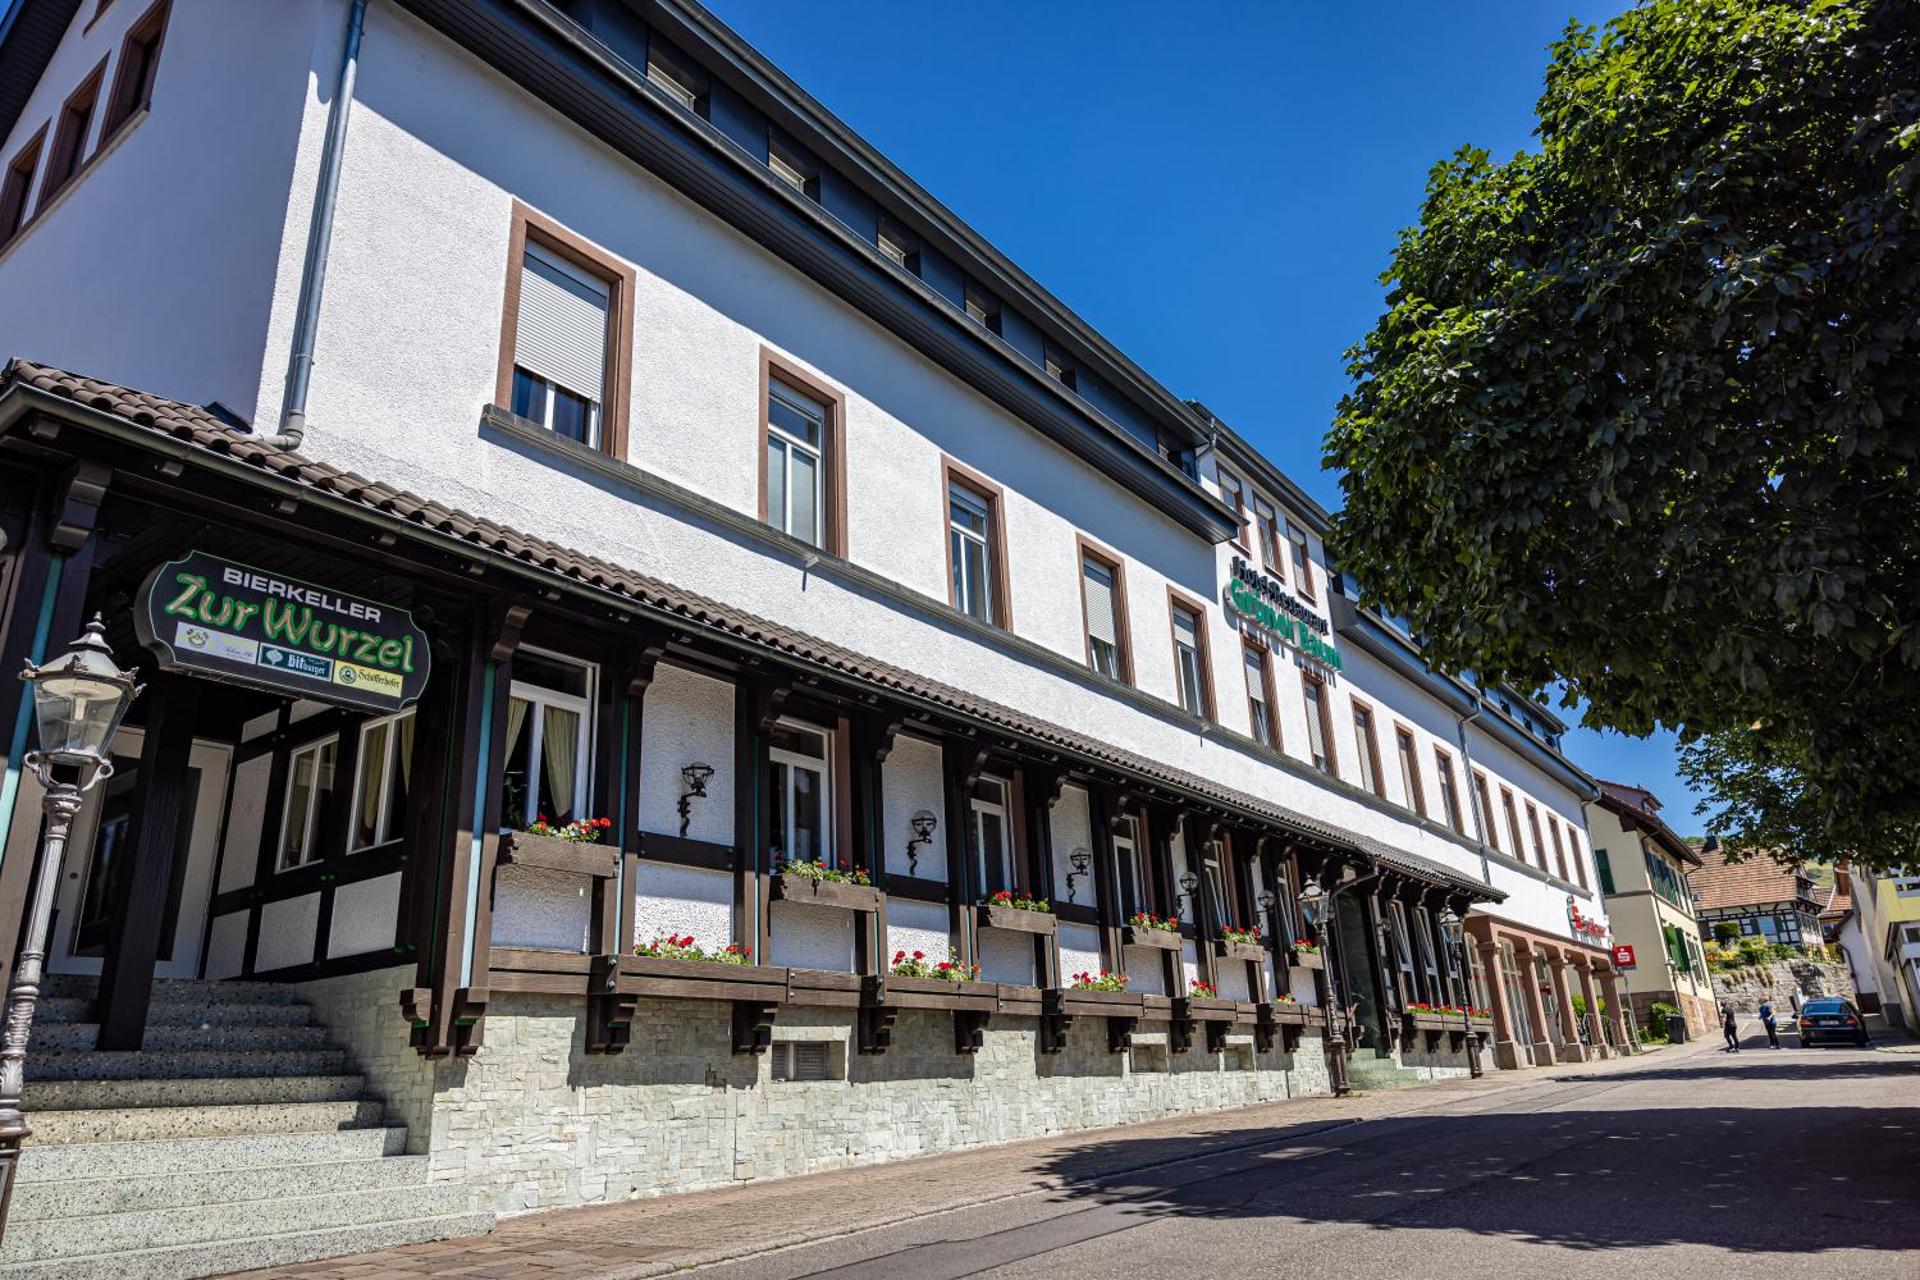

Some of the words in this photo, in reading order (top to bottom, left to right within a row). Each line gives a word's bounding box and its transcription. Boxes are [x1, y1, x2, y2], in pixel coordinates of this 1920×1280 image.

[165, 573, 258, 631] Zur
[263, 598, 415, 673] Wurzel
[223, 567, 382, 623] BIERKELLER
